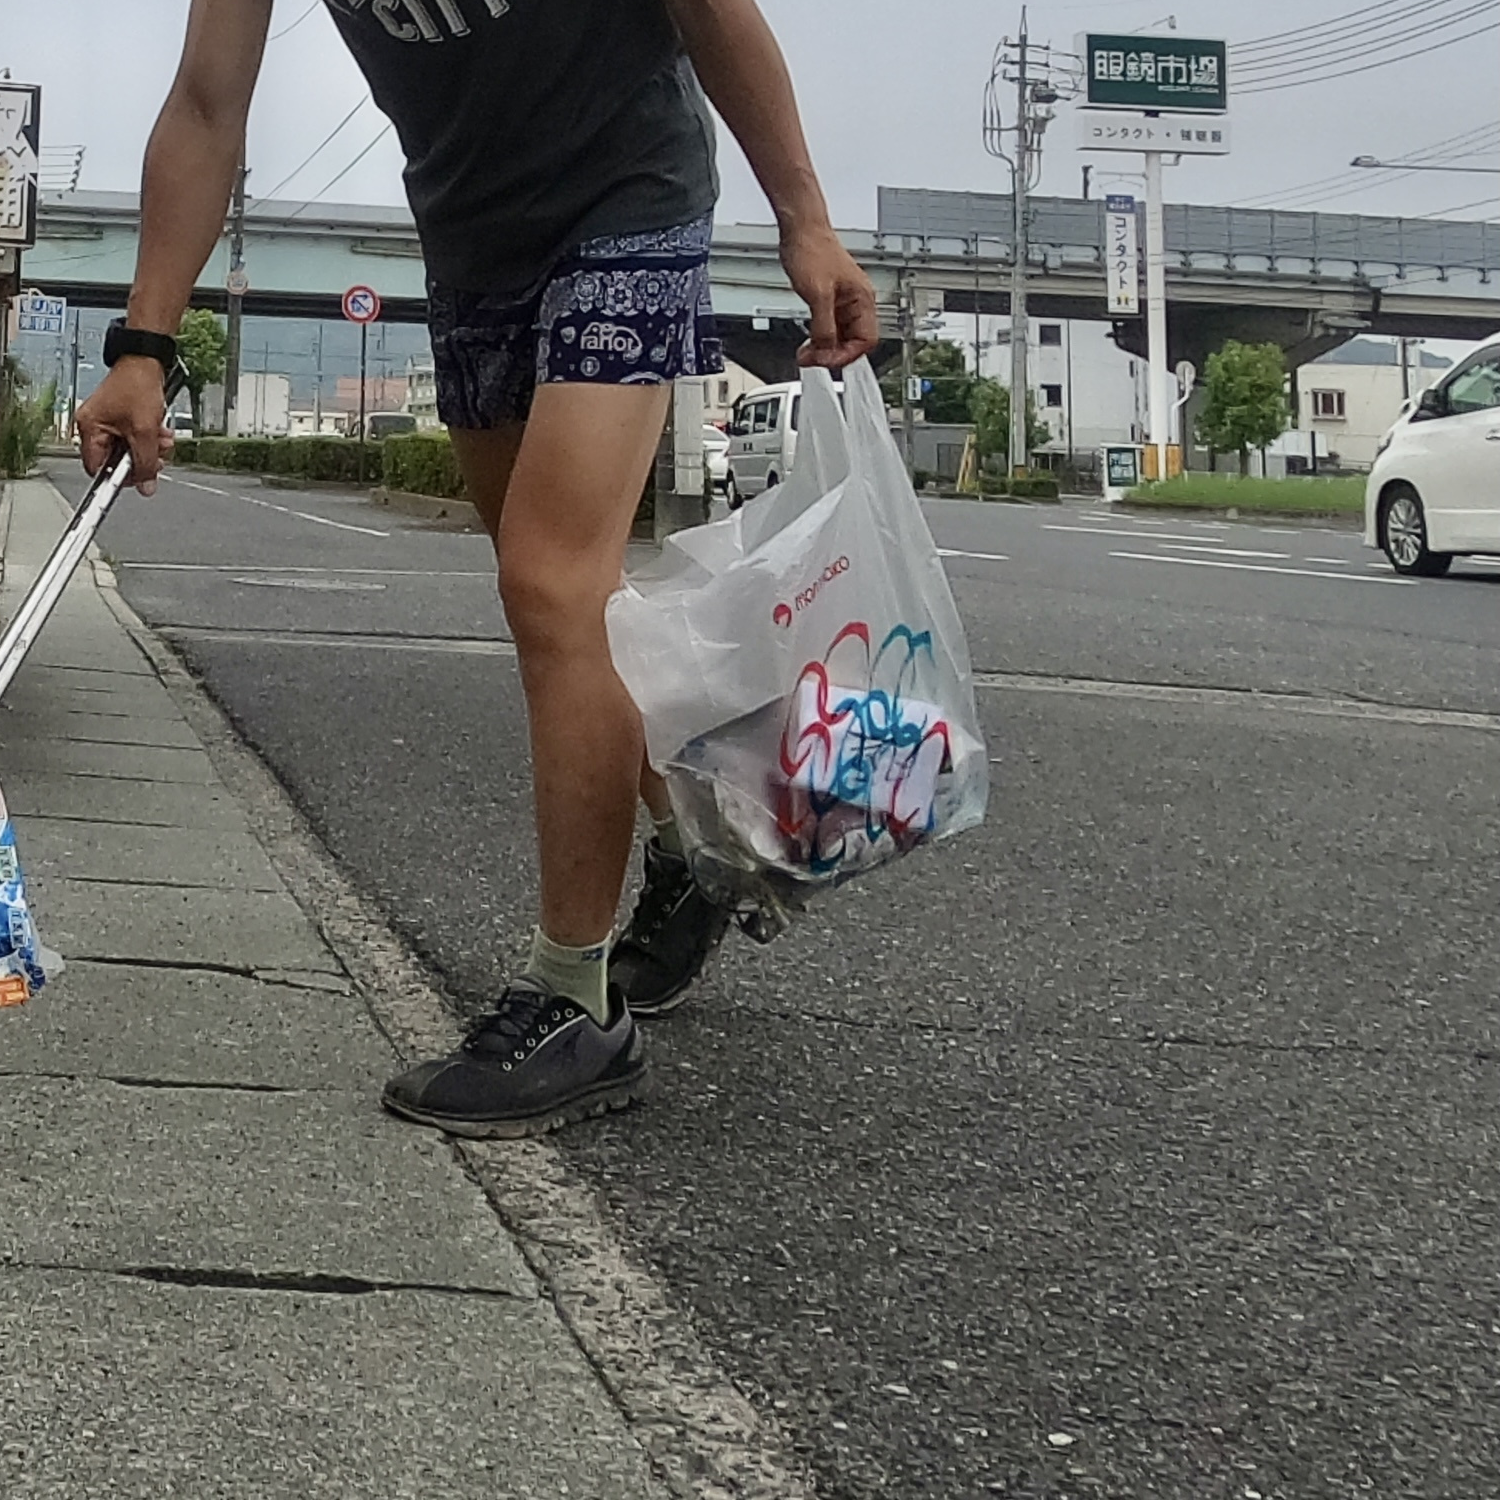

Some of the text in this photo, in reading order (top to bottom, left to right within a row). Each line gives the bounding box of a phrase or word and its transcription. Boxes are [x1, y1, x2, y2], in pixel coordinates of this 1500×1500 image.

[1093, 49, 1220, 86] 眼鏡市場
[1114, 216, 1128, 290] コンタクト
